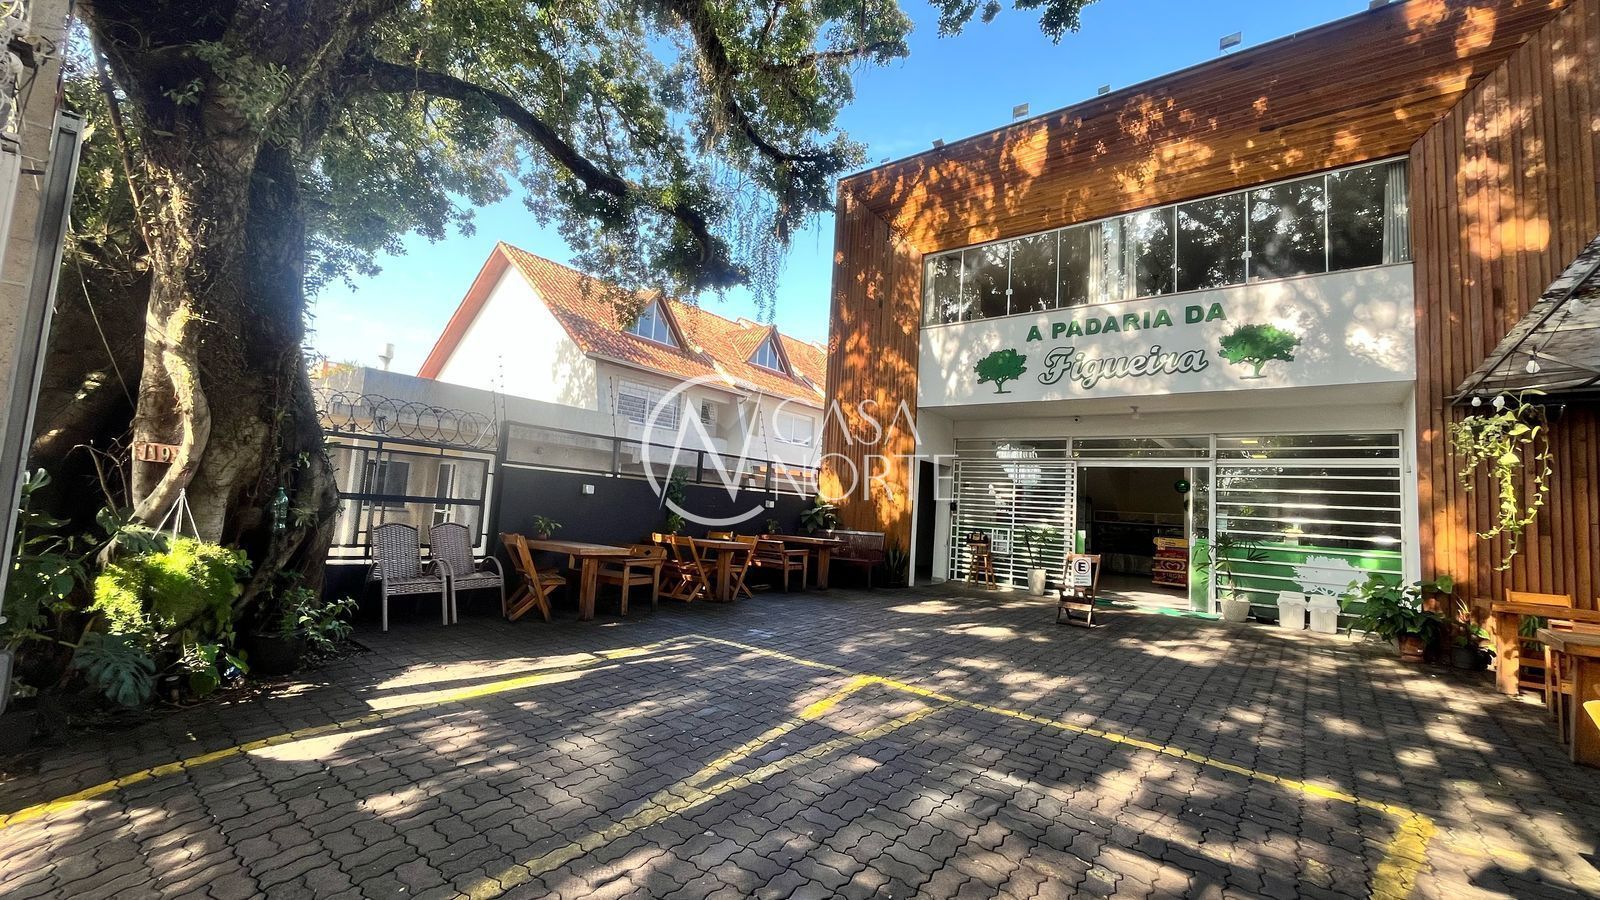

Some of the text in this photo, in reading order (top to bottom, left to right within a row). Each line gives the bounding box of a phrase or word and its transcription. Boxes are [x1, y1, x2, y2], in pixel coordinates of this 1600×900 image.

[1026, 302, 1227, 342] A PADARIA DA
[1038, 345, 1209, 390] Figueira
[1078, 562, 1086, 571] E
